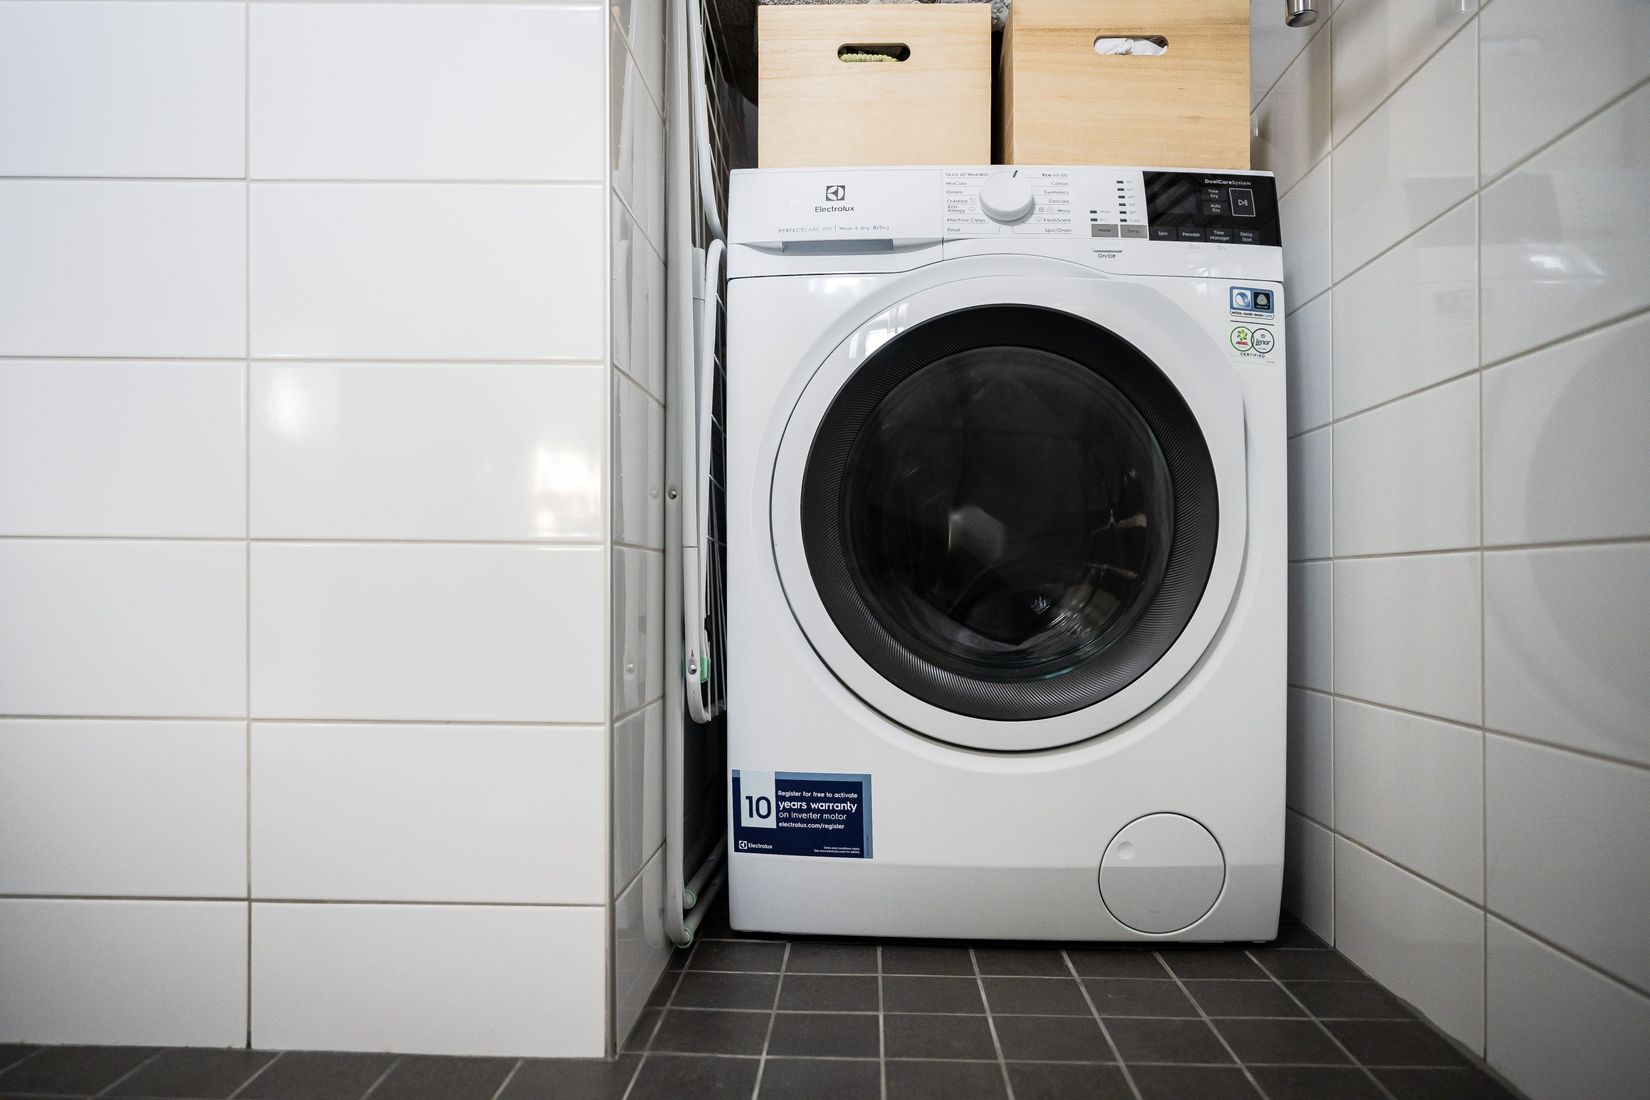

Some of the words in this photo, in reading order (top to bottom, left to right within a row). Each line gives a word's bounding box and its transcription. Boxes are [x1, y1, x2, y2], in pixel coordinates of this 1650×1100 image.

[1204, 178, 1252, 187] DualCareSystem
[814, 205, 855, 213] Electrolux
[777, 790, 802, 799] Register
[745, 795, 772, 820] 10
[778, 800, 807, 811] years
[810, 802, 858, 813] warranty
[791, 811, 821, 820] inverter
[822, 812, 847, 821] motor
[778, 822, 845, 831] electrolux.com/register
